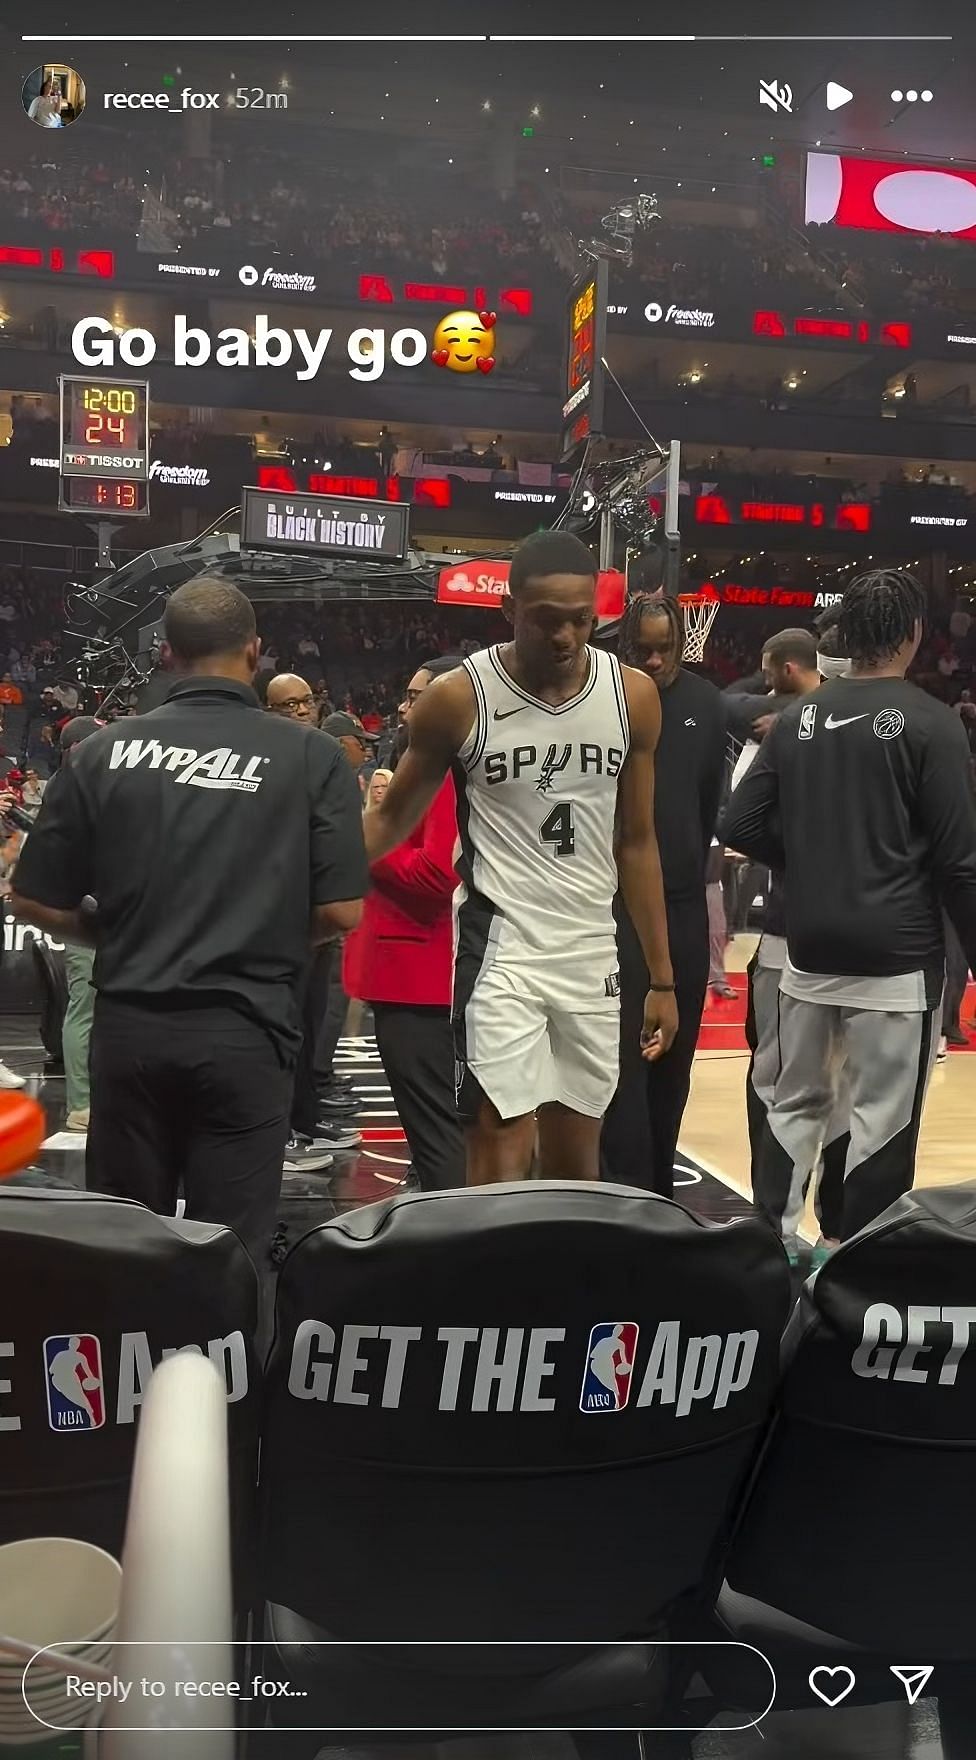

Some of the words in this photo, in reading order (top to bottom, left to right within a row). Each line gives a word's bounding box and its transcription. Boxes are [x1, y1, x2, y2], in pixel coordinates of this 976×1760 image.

[83, 388, 135, 413] 12:00
[85, 413, 125, 443] 24
[538, 800, 575, 858] 4
[288, 1319, 421, 1408] GET
[437, 1327, 566, 1412] THE
[635, 1320, 760, 1418] App
[57, 1410, 84, 1426] NBA
